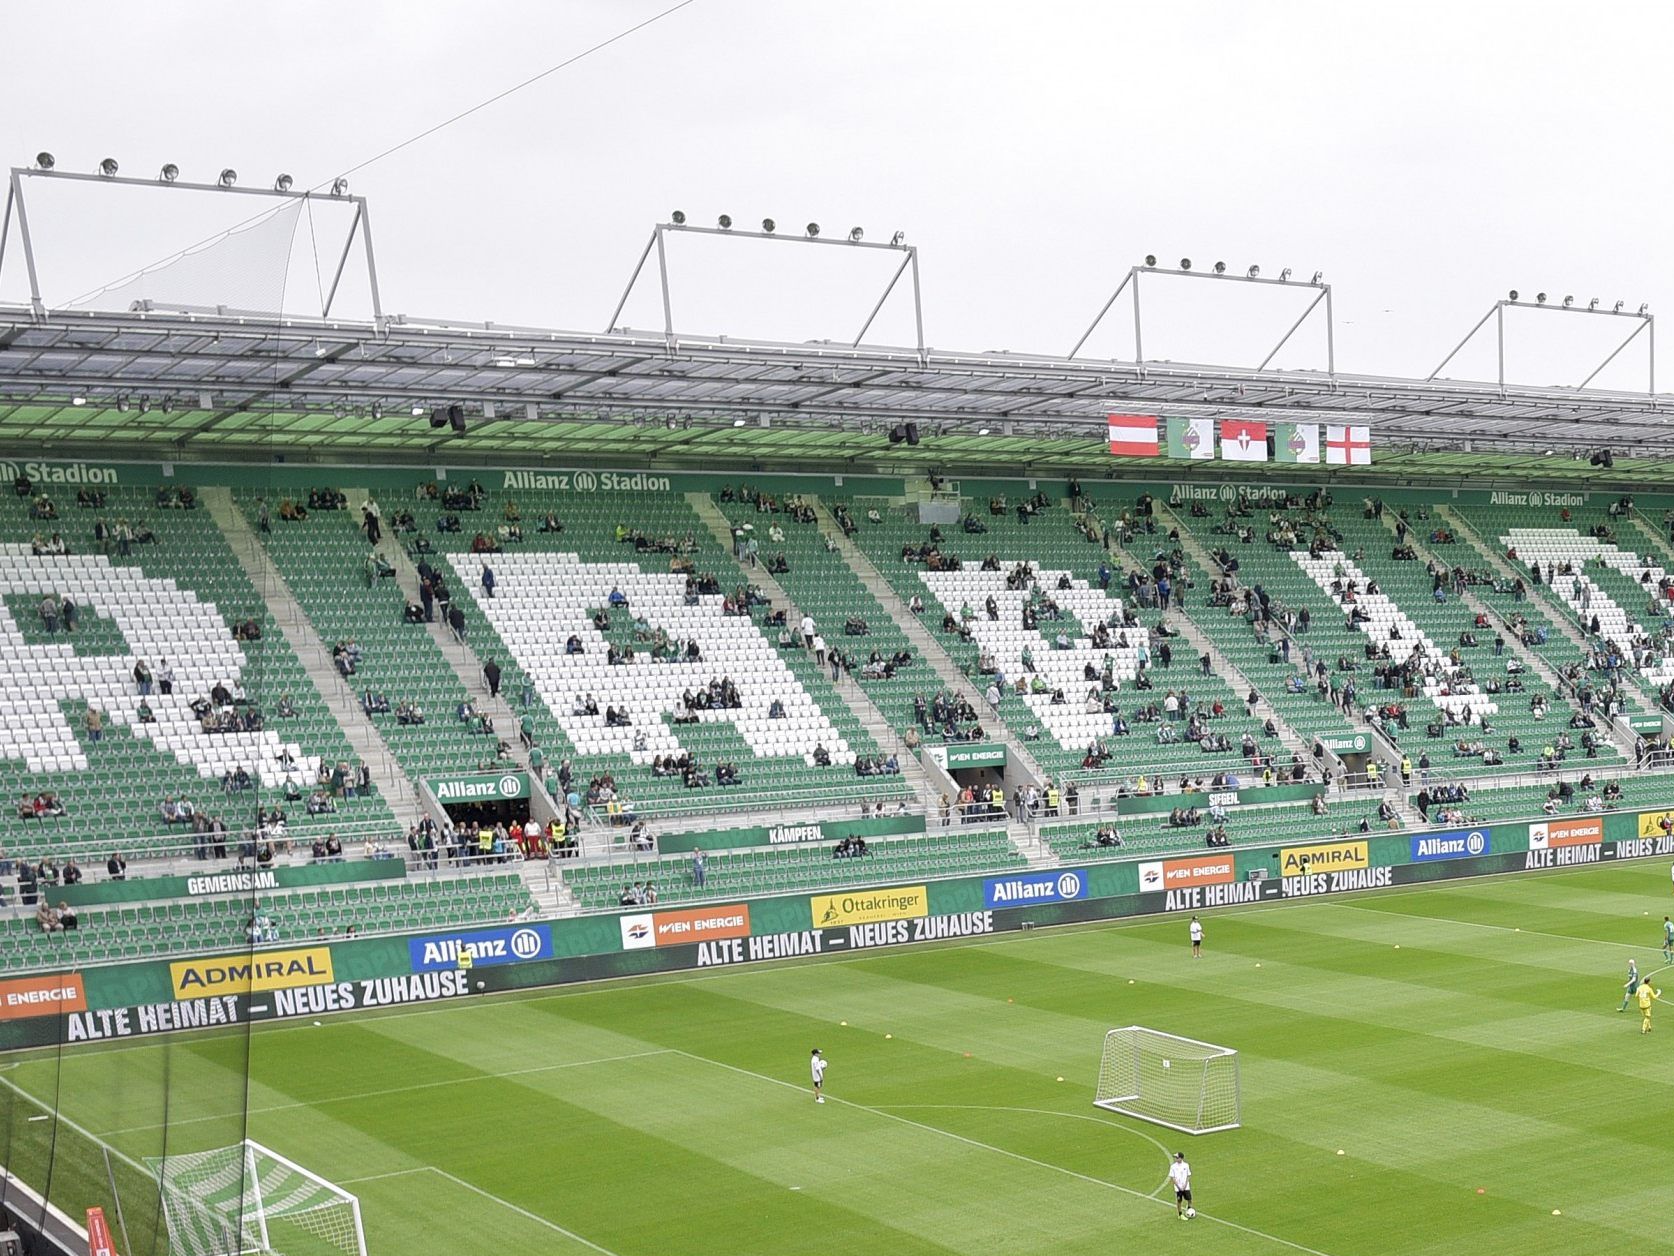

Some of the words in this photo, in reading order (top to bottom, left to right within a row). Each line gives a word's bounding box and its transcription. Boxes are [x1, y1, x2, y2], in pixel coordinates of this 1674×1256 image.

[24, 462, 119, 483] Stadion
[503, 471, 570, 490] Allianz
[600, 472, 671, 491] Stadion
[1171, 484, 1218, 500] Allianz
[1238, 485, 1287, 500] Stadion
[1489, 491, 1528, 506] Allianz
[1543, 492, 1584, 507] Stadion
[949, 752, 970, 762] WIEN
[971, 750, 1004, 761] ENERGIE
[437, 781, 497, 798] Allianz
[1208, 791, 1240, 807] SIEGEN.
[768, 824, 825, 845] KÄMPFEN.
[1550, 829, 1570, 840] WIEN
[1570, 826, 1600, 839] ENERGIE
[1284, 846, 1366, 870] ADMIRAL
[1417, 838, 1465, 857] Allianz
[1525, 850, 1554, 870] ALTE
[1556, 843, 1602, 866] HEIMAT
[1616, 837, 1653, 859] NEUES
[1166, 868, 1191, 880] WIEN
[1193, 864, 1231, 877] ENERGIE
[187, 870, 280, 896] GEMEINSAM.
[993, 880, 1055, 901] Allianz
[1165, 888, 1201, 911] ALTE
[1205, 881, 1262, 907] HEIMAT
[1281, 874, 1328, 898] NEUES
[1330, 866, 1393, 892] ZUHAUSE
[841, 893, 920, 914] Ottakringer
[658, 920, 691, 934] WIEN
[694, 915, 744, 930] ENERGIE
[697, 937, 744, 966] ALTE
[749, 929, 824, 960] HEIMAT
[849, 919, 910, 949] NEUES
[913, 910, 994, 940] ZUHAUSE
[423, 939, 507, 965] Allianz
[178, 956, 327, 991] ADMIRAL
[7, 986, 77, 1006] ENERGIE
[68, 1007, 132, 1042] ALTE
[137, 995, 238, 1033] HEIMAT
[273, 982, 355, 1017] NEUES
[361, 969, 469, 1006] ZUHAUSE
